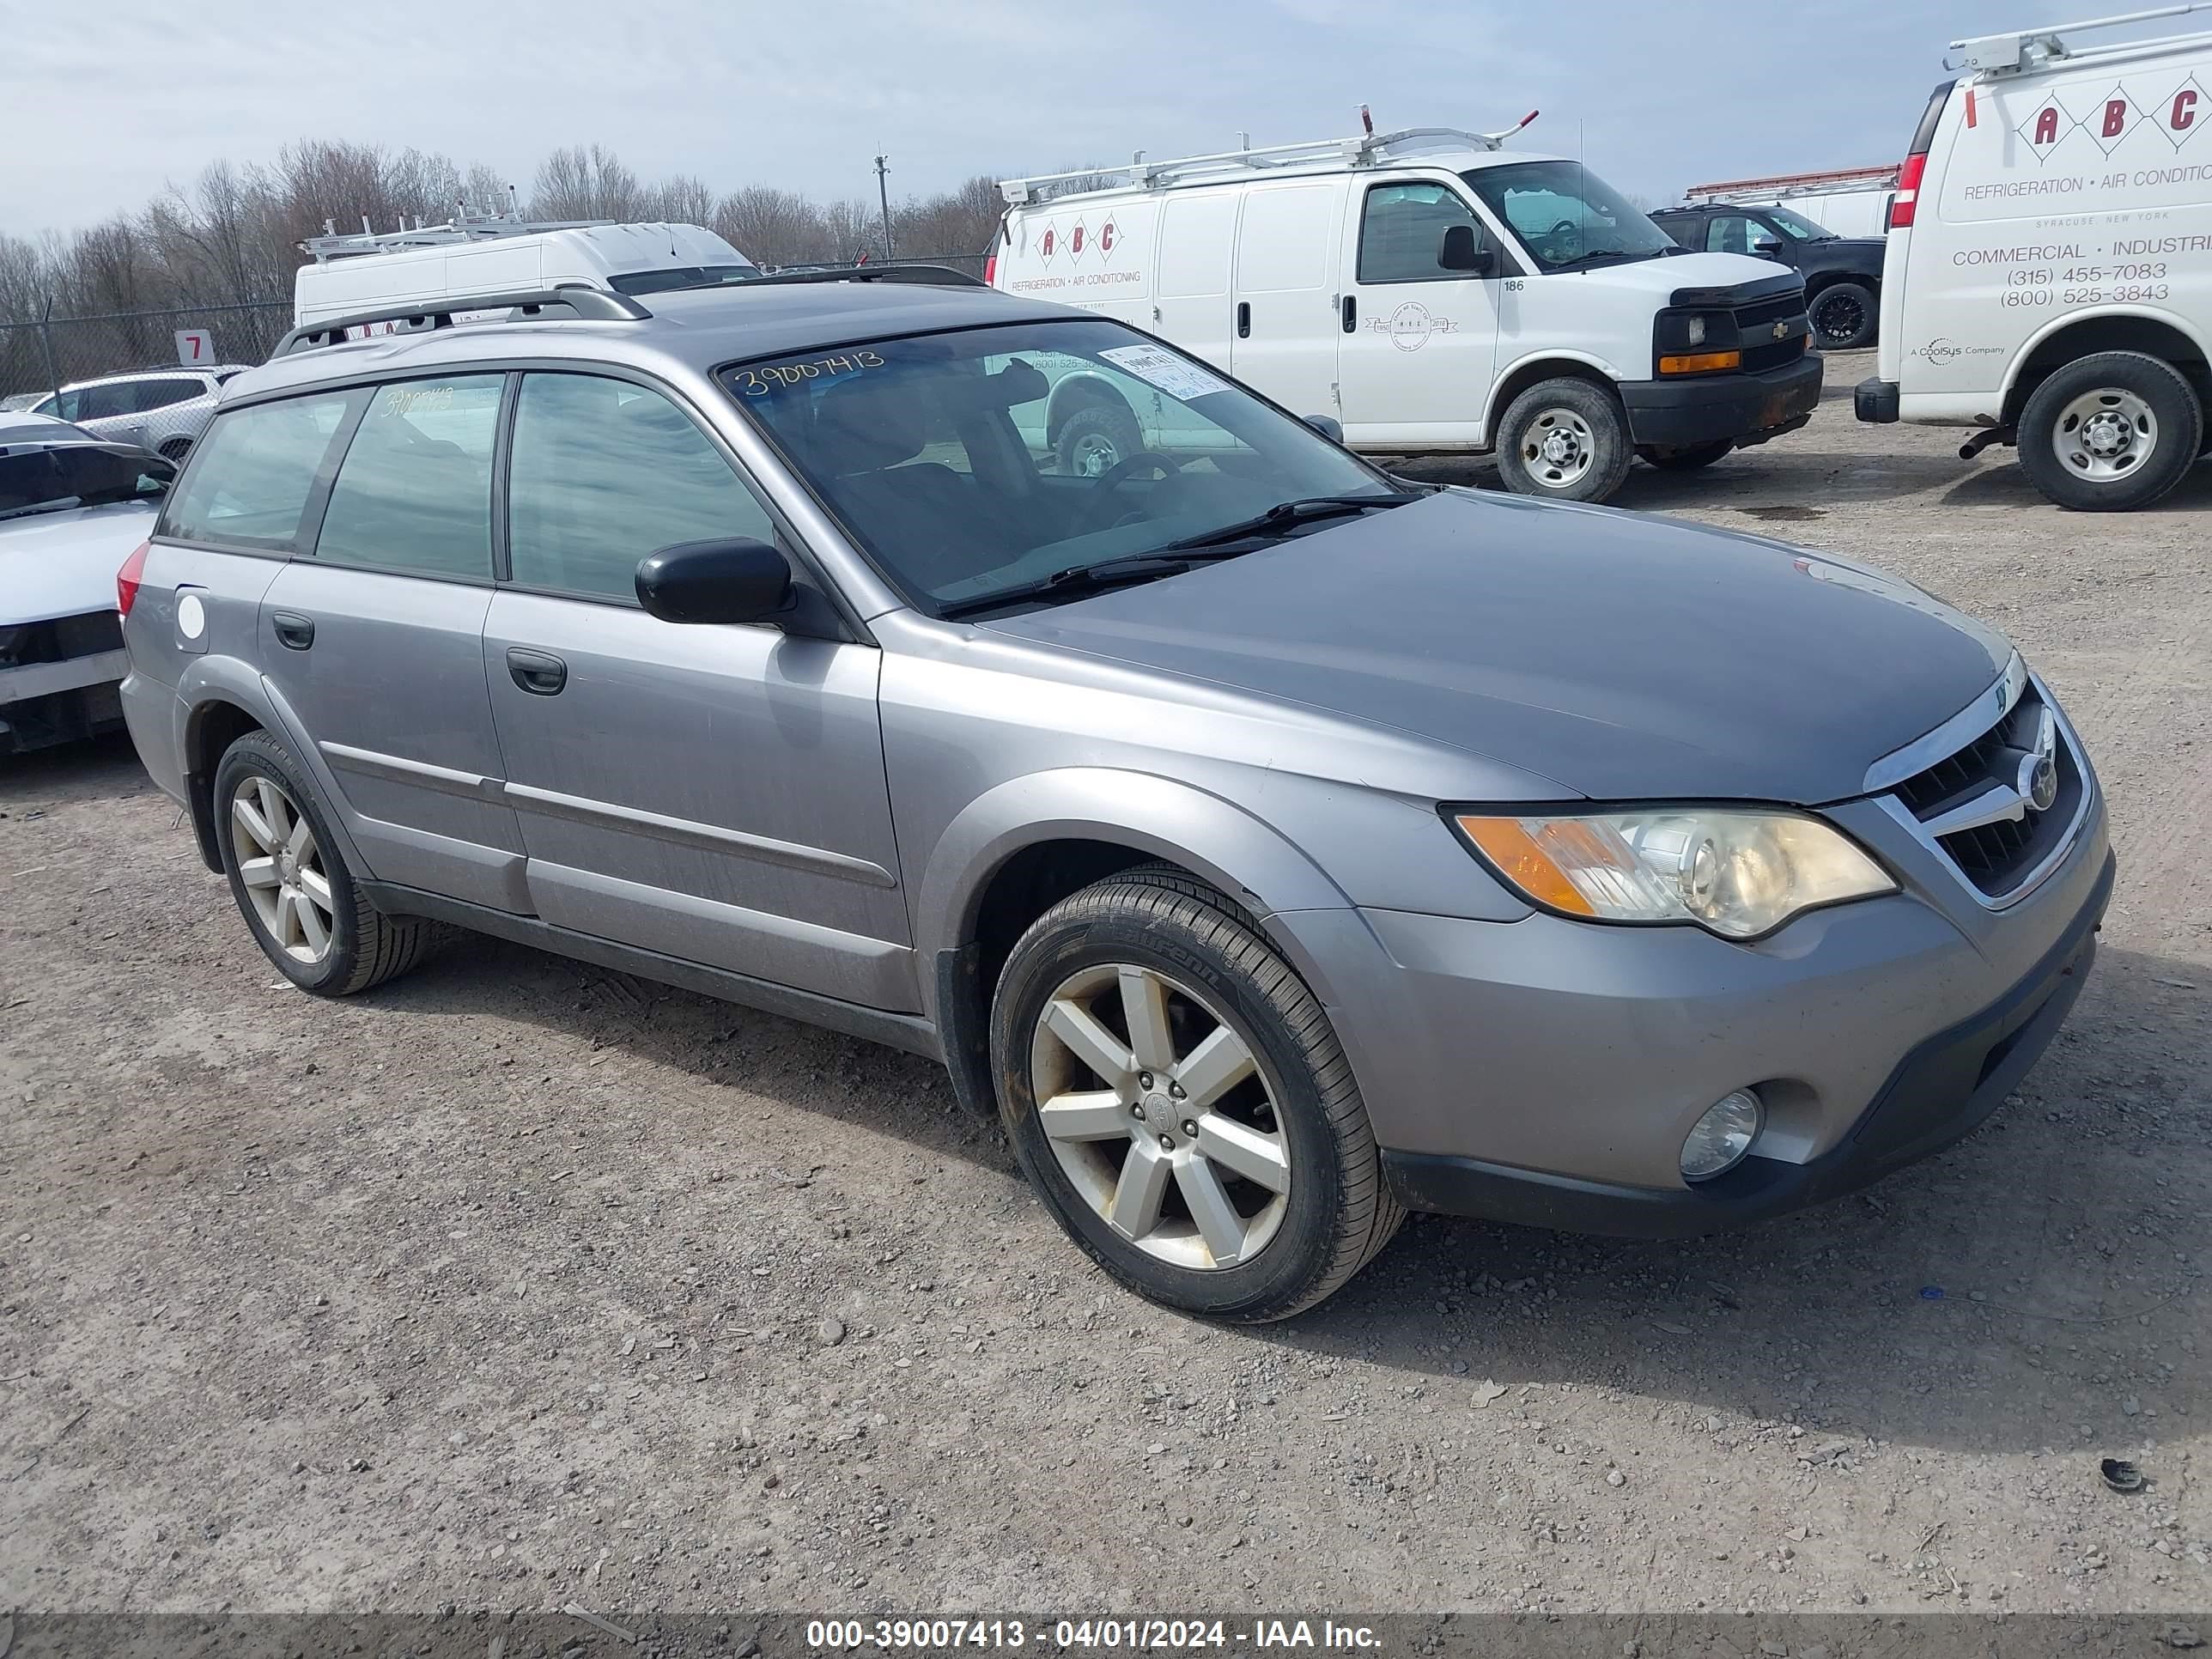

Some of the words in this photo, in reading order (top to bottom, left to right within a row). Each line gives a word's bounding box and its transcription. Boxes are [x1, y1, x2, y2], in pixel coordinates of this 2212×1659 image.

[2034, 108, 2058, 144] A
[2102, 100, 2126, 137] B
[2171, 90, 2197, 131] C
[1965, 177, 2083, 200] REFRIGERATION
[2100, 173, 2127, 189] AIR
[2106, 213, 2130, 223] NEW
[2137, 211, 2170, 221] YORK
[1043, 230, 1054, 256] A
[1073, 228, 1084, 252] B
[1102, 223, 1114, 251] C
[1953, 245, 2087, 266] COMMERCIAL
[1012, 277, 1066, 292] REFRIGERATION
[1073, 275, 1085, 286] AIR
[1087, 271, 1140, 285] CONDITIONING
[1504, 281, 1524, 291] 186
[2008, 268, 2054, 287] (315)
[2063, 263, 2166, 283] 455-7083
[2001, 289, 2054, 308] (800)
[2063, 284, 2169, 304] 525-3843
[185, 337, 201, 360] 7
[1919, 347, 1962, 357] CoolSys
[1966, 347, 2005, 356] Company
[735, 351, 884, 395] 39007413
